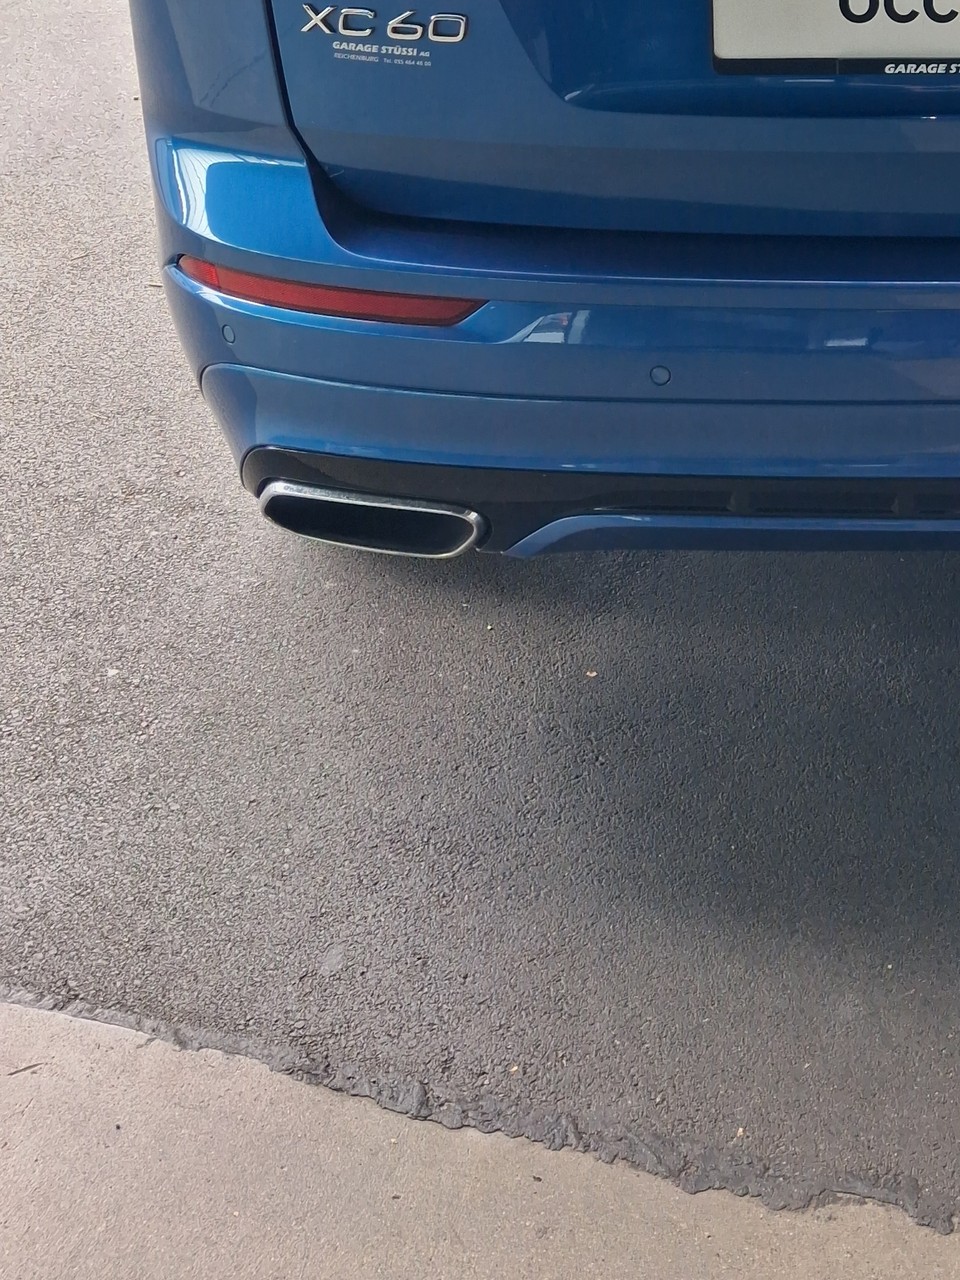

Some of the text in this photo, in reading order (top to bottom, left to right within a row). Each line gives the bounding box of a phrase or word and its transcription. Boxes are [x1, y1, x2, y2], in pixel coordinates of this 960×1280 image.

[332, 41, 380, 53] GARAGE
[380, 45, 418, 57] STÜSSI
[333, 52, 379, 63] REICHENBURG
[884, 63, 947, 74] GARAGE
